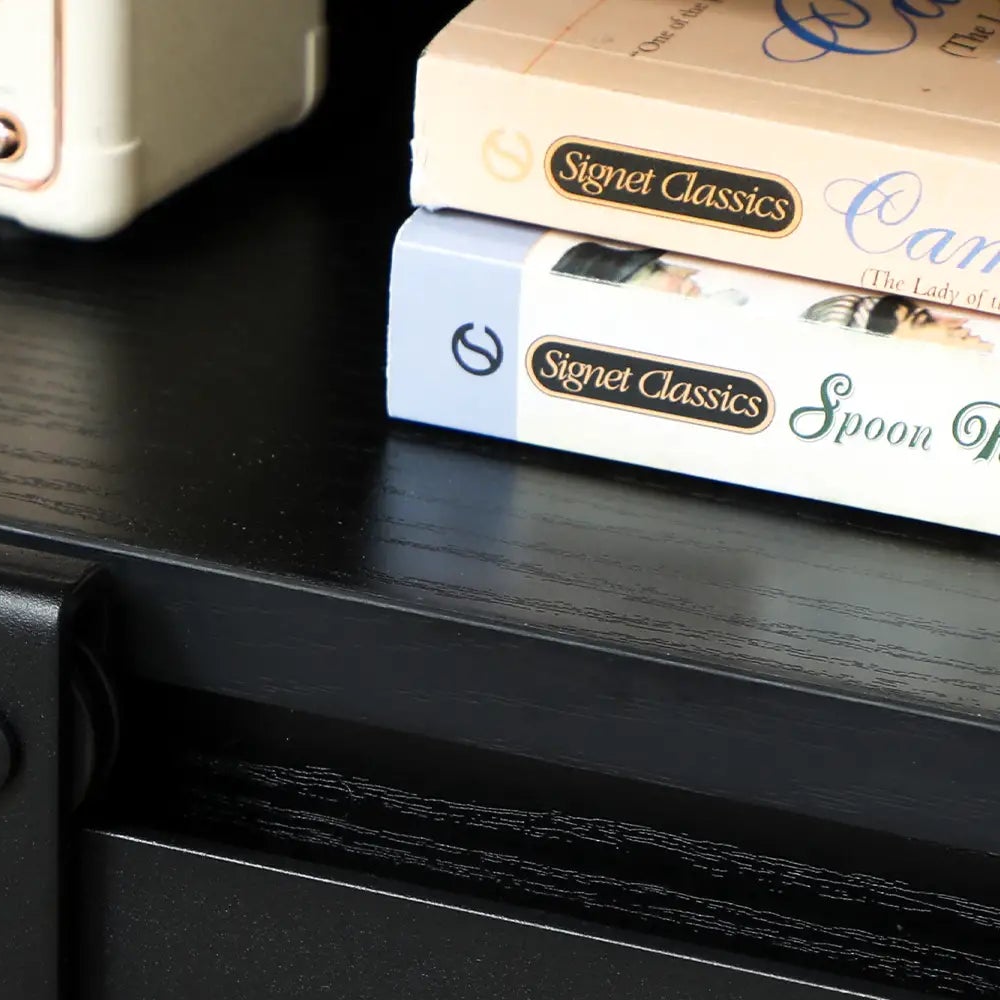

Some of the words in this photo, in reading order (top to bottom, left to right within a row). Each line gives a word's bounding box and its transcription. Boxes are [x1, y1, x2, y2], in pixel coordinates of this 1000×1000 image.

[669, 15, 689, 31] of
[679, 2, 709, 18] the
[939, 25, 995, 59] (The
[559, 150, 656, 195] Signet
[661, 169, 790, 221] Classics
[860, 268, 905, 291] (The
[913, 276, 960, 305] Lady
[967, 289, 989, 309] of
[540, 349, 633, 393] Signet
[638, 368, 763, 418] Classics
[788, 372, 933, 451] Spoon
